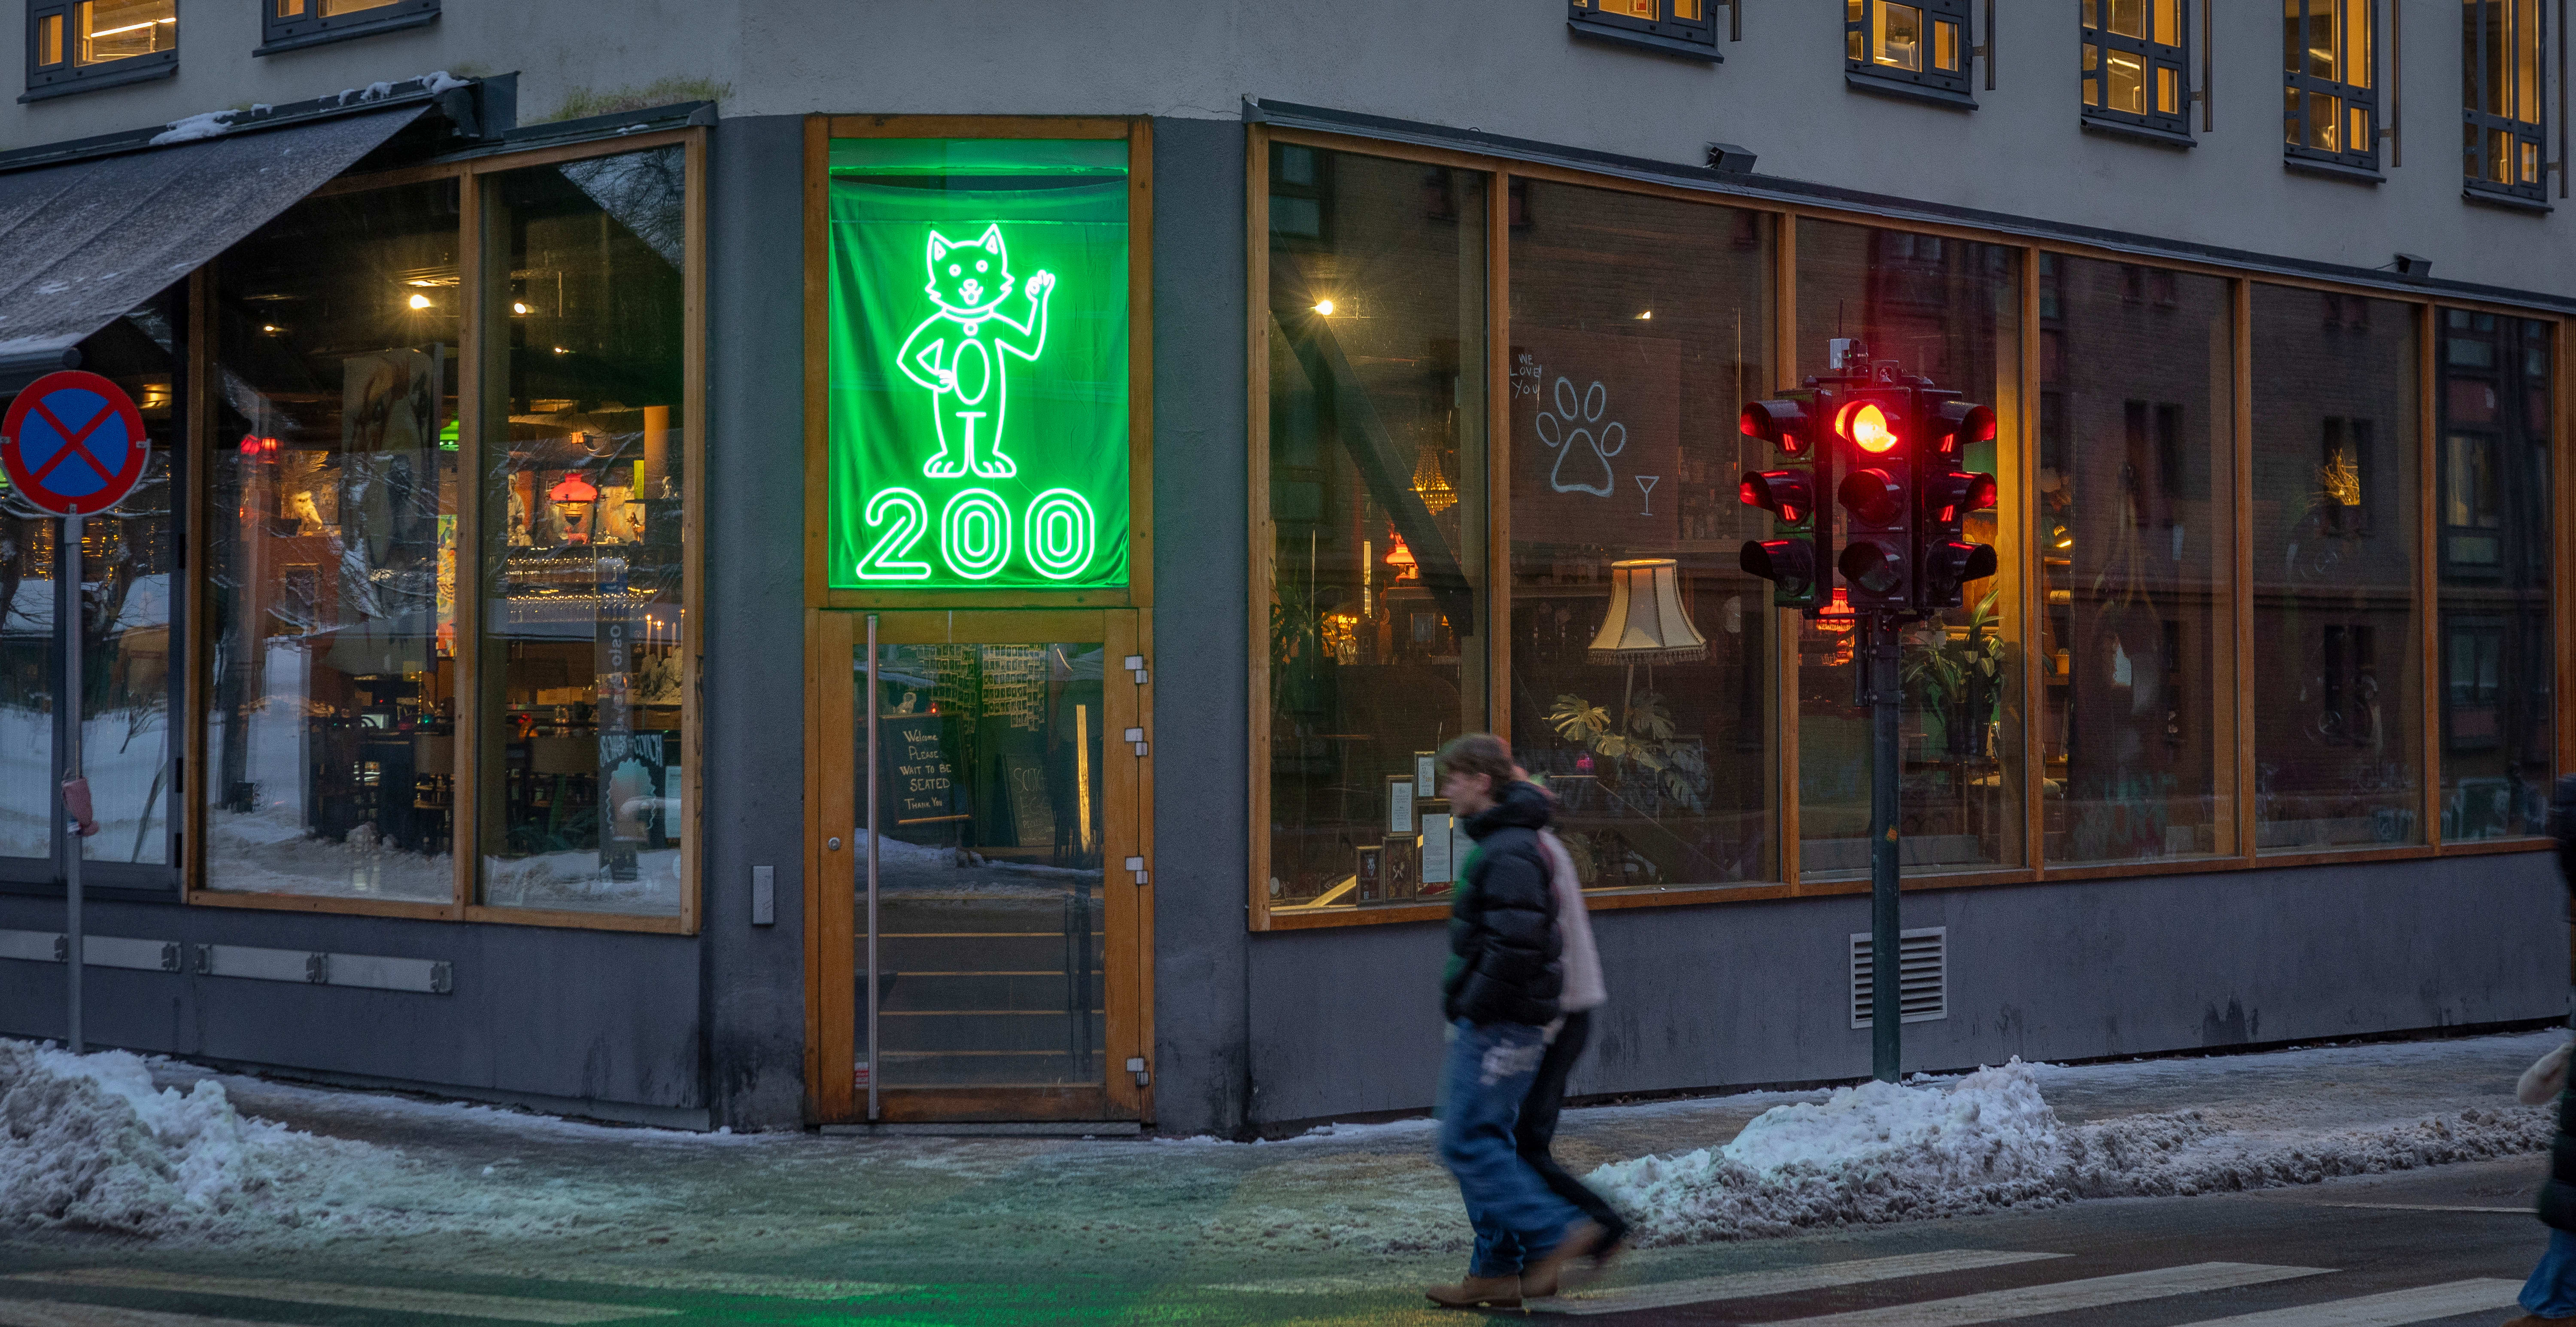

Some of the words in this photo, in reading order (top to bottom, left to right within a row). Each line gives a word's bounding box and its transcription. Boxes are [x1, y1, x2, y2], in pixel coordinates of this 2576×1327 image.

[1518, 353, 1534, 365] WE
[1509, 364, 1540, 378] LOVE
[1511, 380, 1538, 399] YOU
[856, 487, 1095, 580] 200
[902, 729, 938, 743] Welcome
[908, 746, 939, 760] PLEASE
[899, 765, 922, 775] WAIT
[925, 765, 935, 773] TO
[939, 764, 952, 773] BE
[909, 778, 951, 792] SEATED
